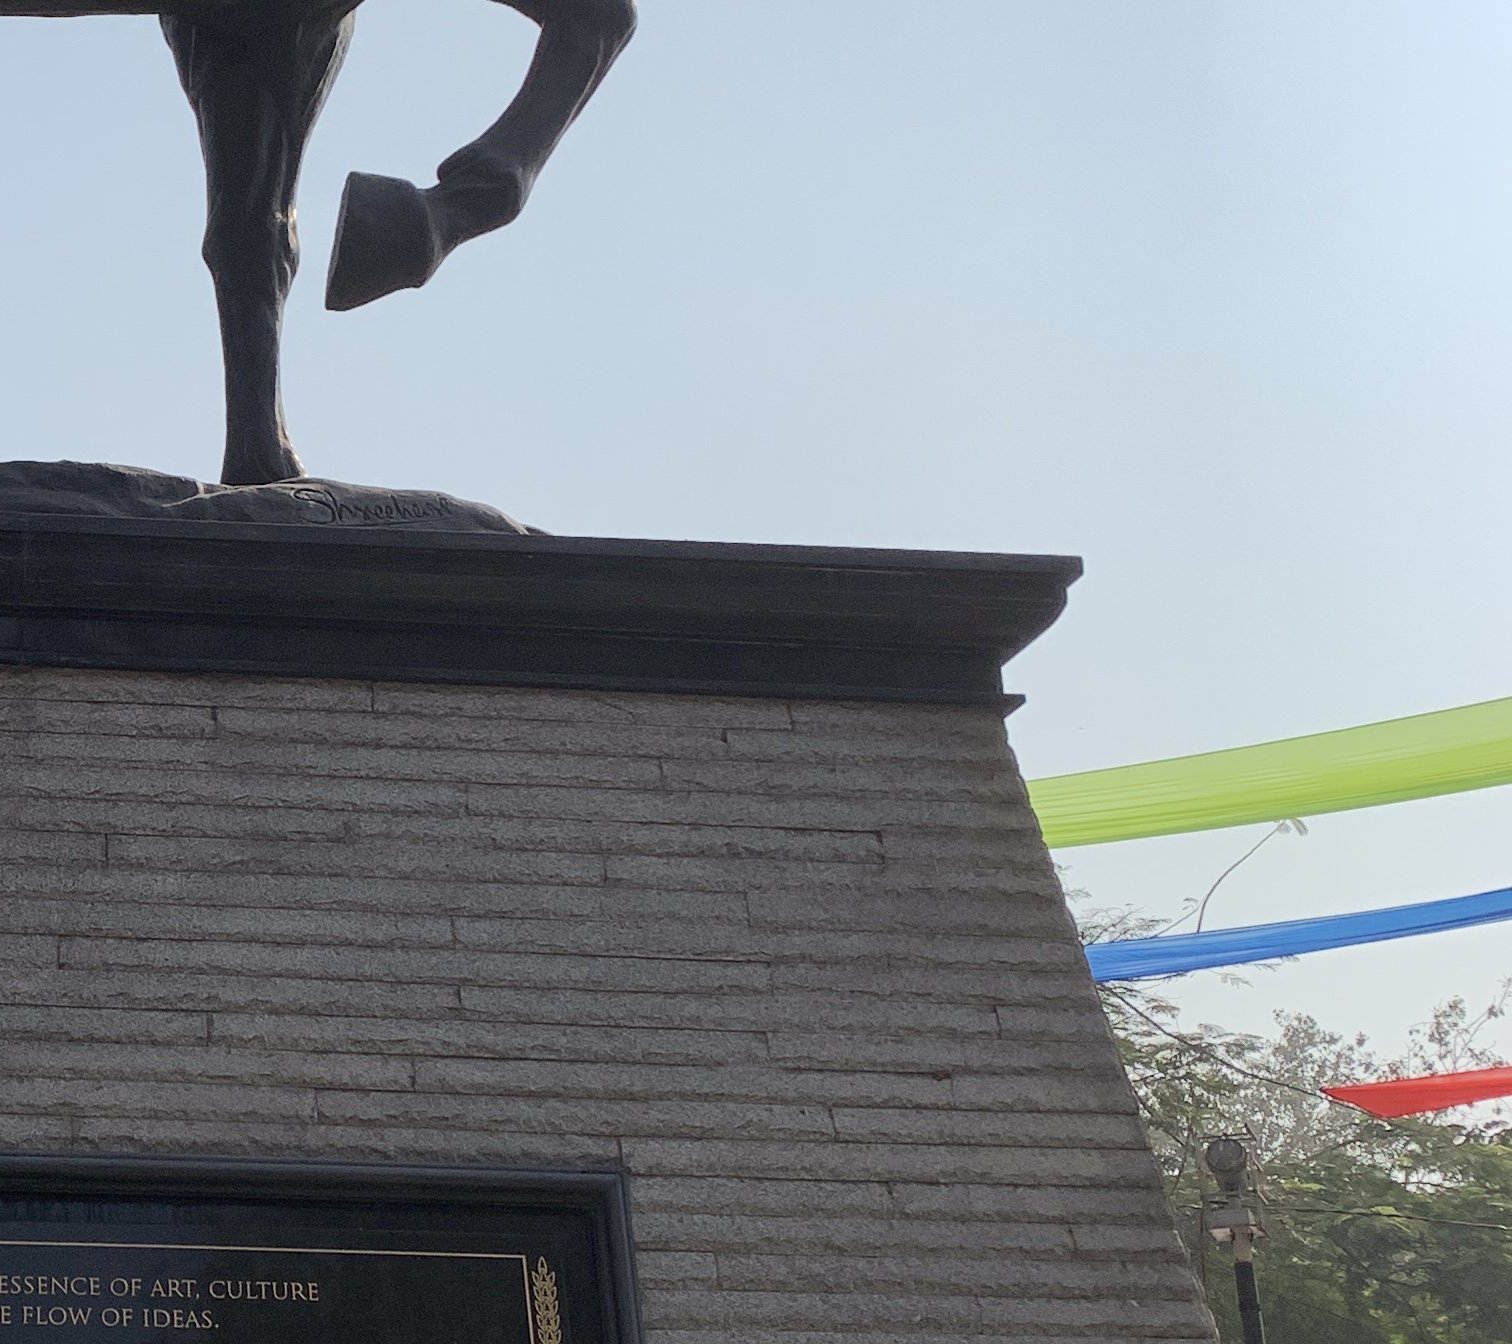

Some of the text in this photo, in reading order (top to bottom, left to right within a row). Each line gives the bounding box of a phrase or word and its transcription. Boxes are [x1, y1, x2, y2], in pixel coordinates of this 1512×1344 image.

[109, 1277, 142, 1297] OF
[150, 1278, 200, 1300] ART,
[209, 1280, 320, 1302] CULTURE
[22, 1305, 92, 1326] FLOW
[101, 1307, 133, 1327] OF
[142, 1308, 220, 1329] IDEAS.
